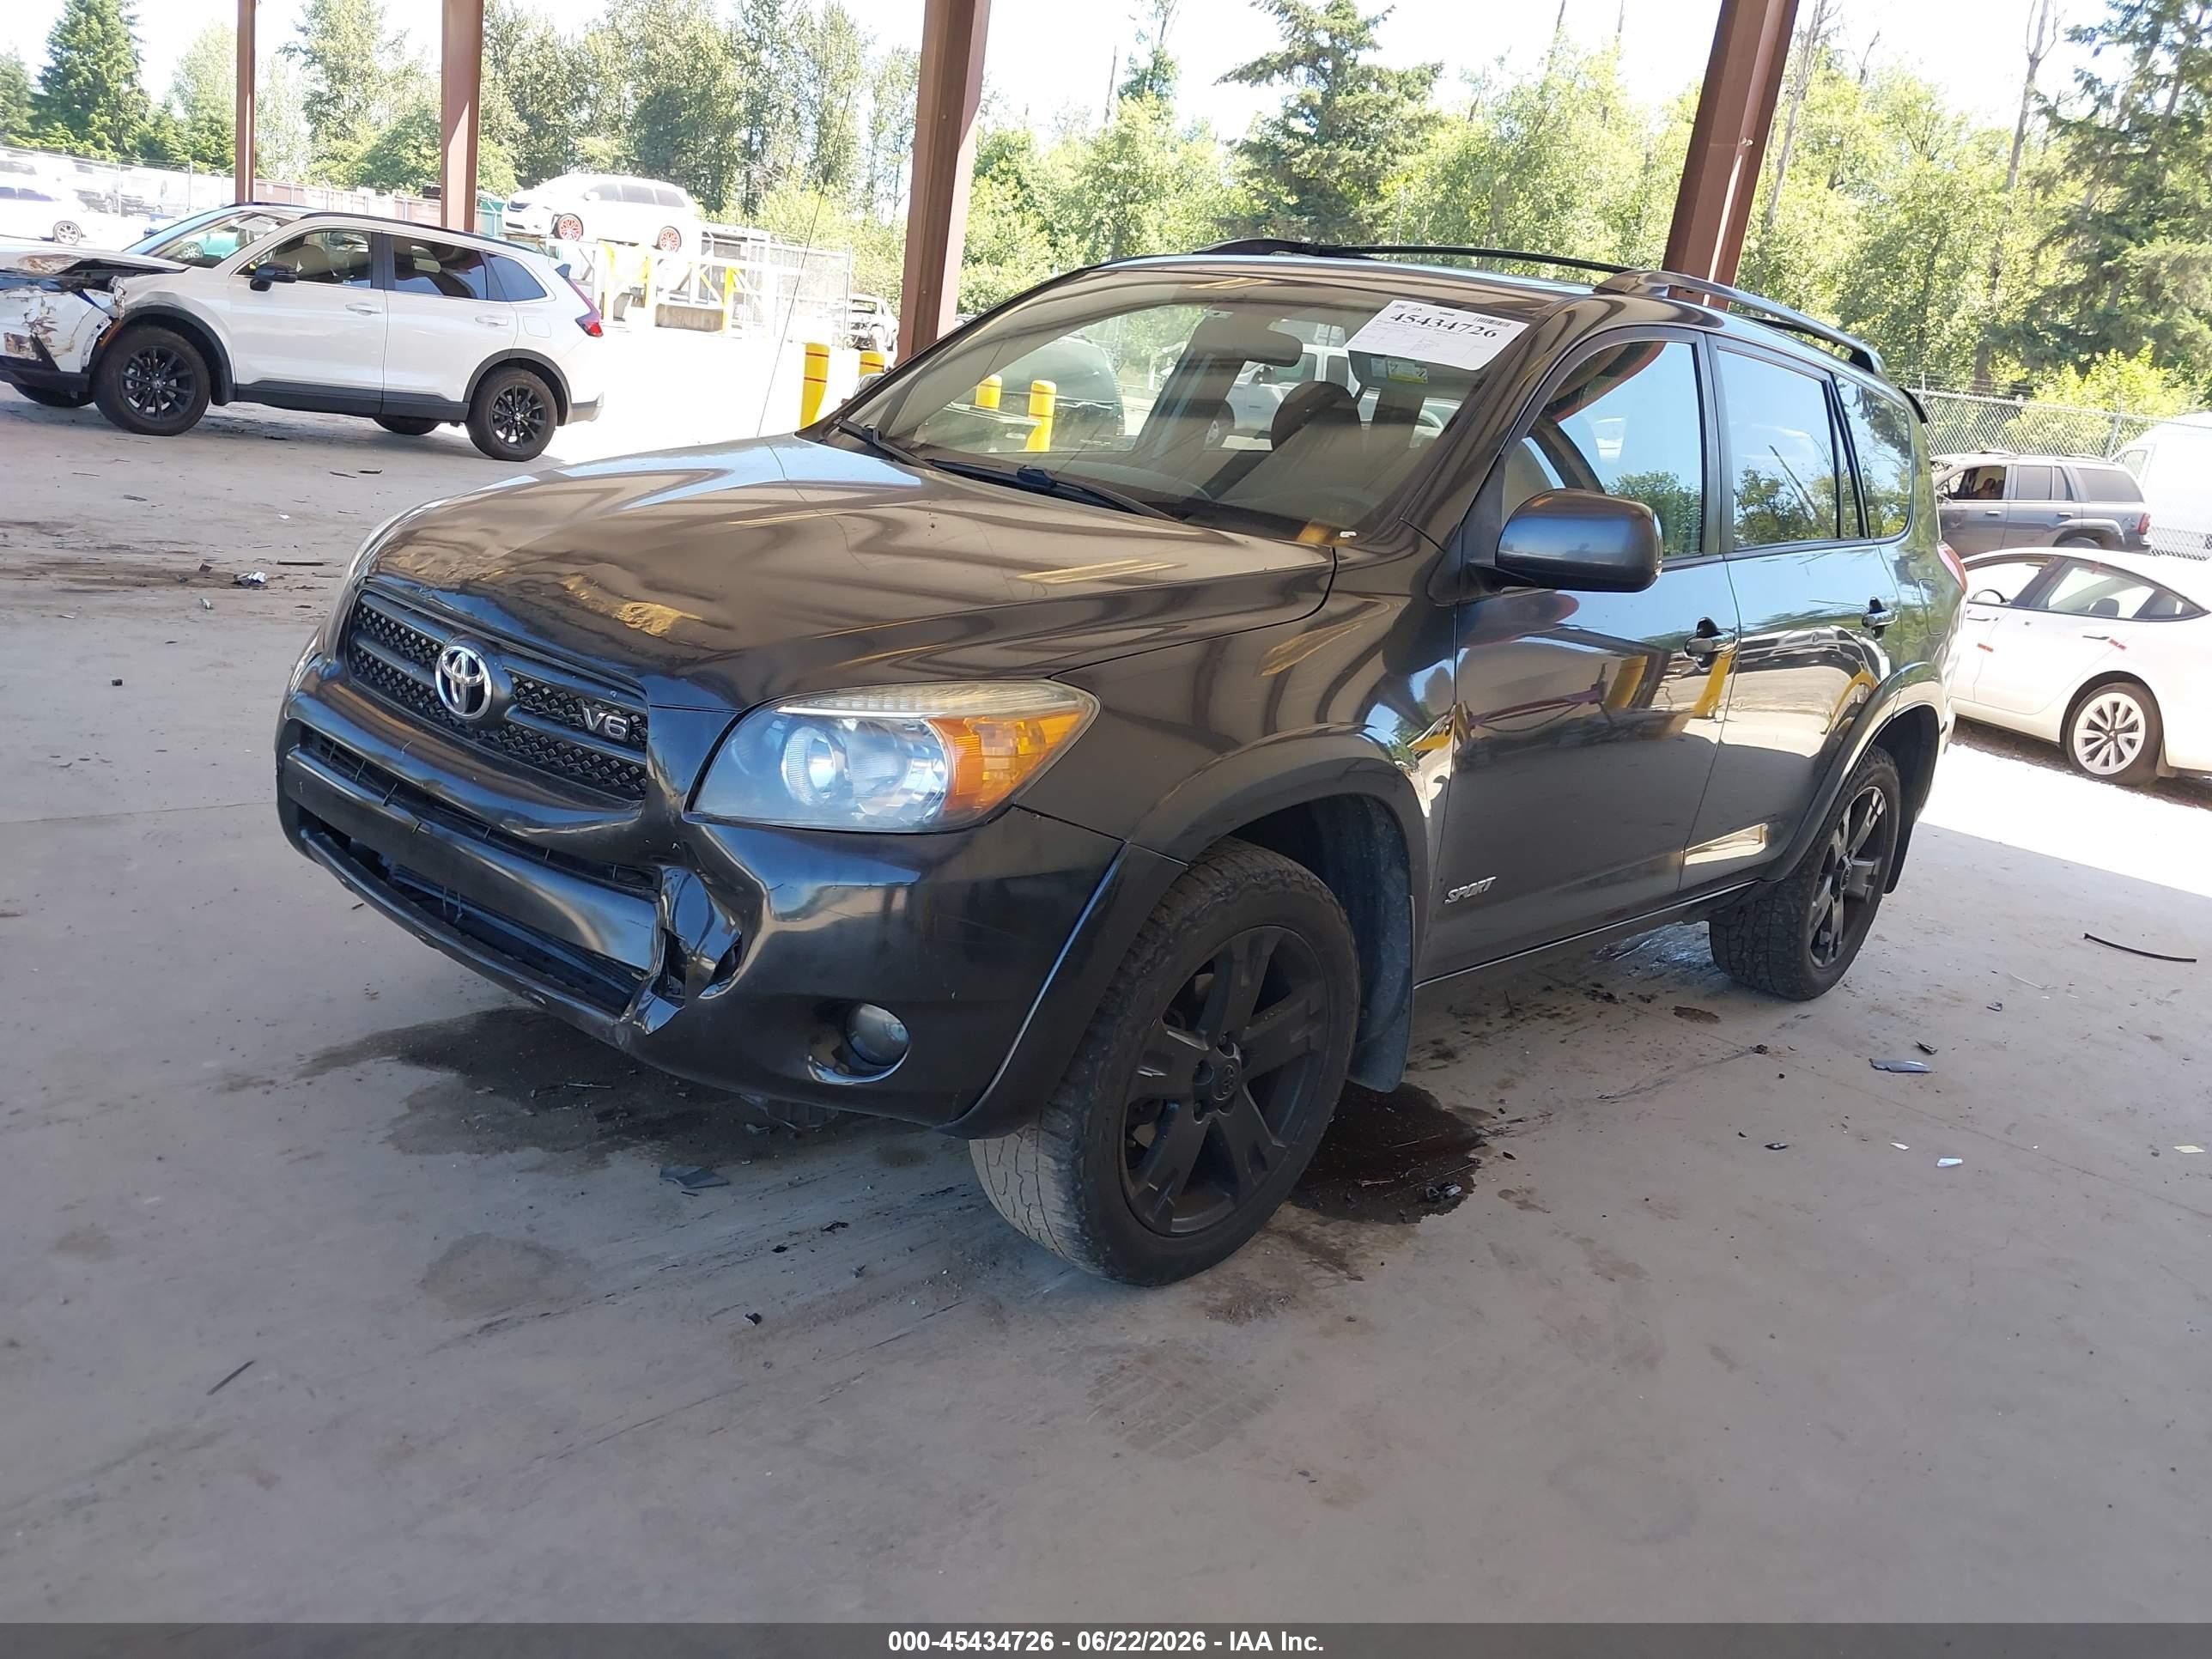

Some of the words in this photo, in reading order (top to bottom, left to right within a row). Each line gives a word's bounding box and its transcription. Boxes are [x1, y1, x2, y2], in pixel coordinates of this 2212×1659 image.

[1389, 313, 1499, 337] 45434726
[583, 707, 628, 741] V6
[1444, 876, 1496, 904] SPORT
